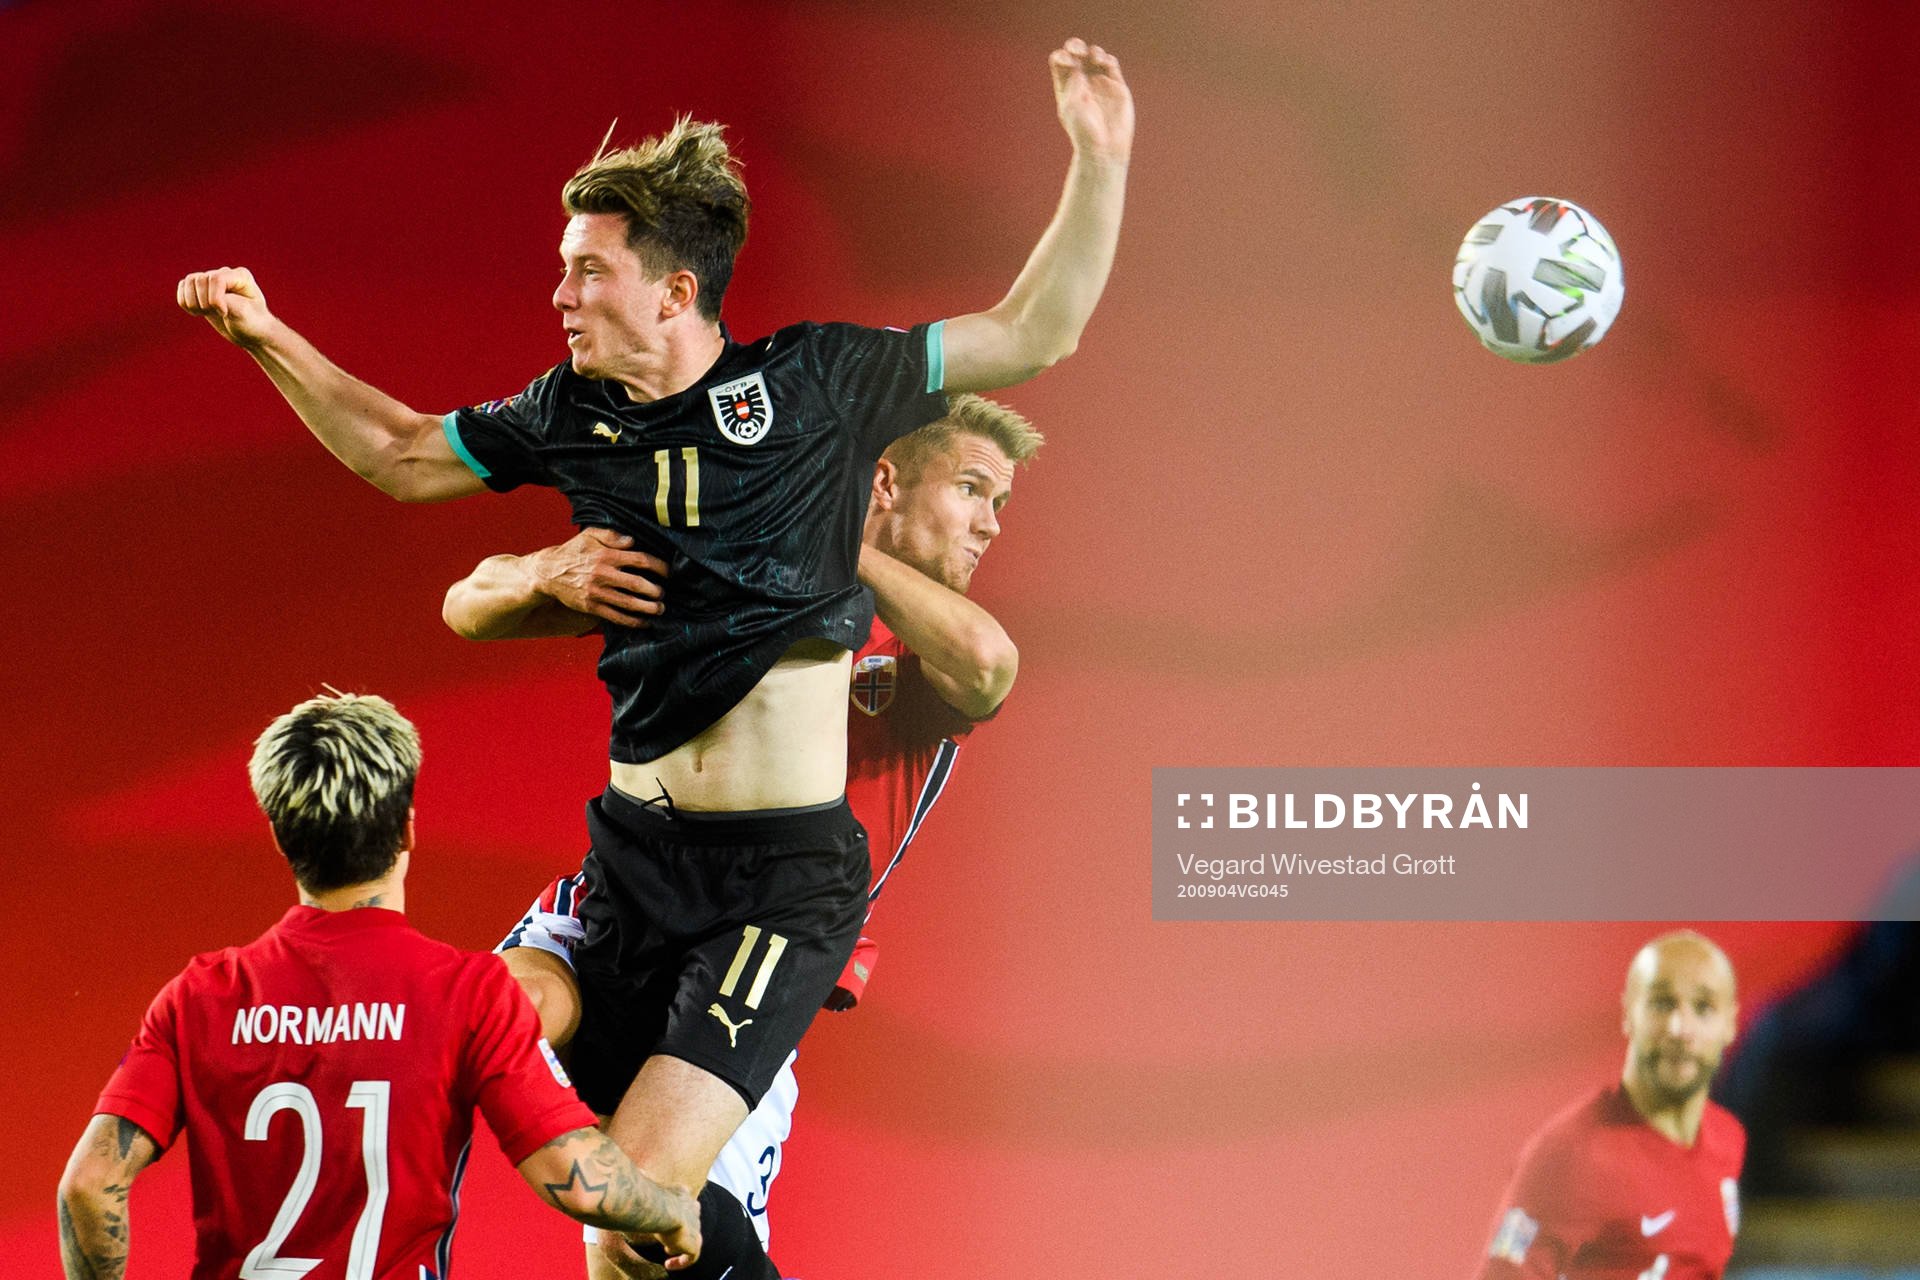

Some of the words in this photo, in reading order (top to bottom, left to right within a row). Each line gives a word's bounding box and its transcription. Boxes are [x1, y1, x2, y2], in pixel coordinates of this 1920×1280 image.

[654, 446, 700, 527] 11
[719, 924, 789, 1010] 11
[231, 1002, 406, 1046] NORMANN
[238, 1080, 391, 1280] 21
